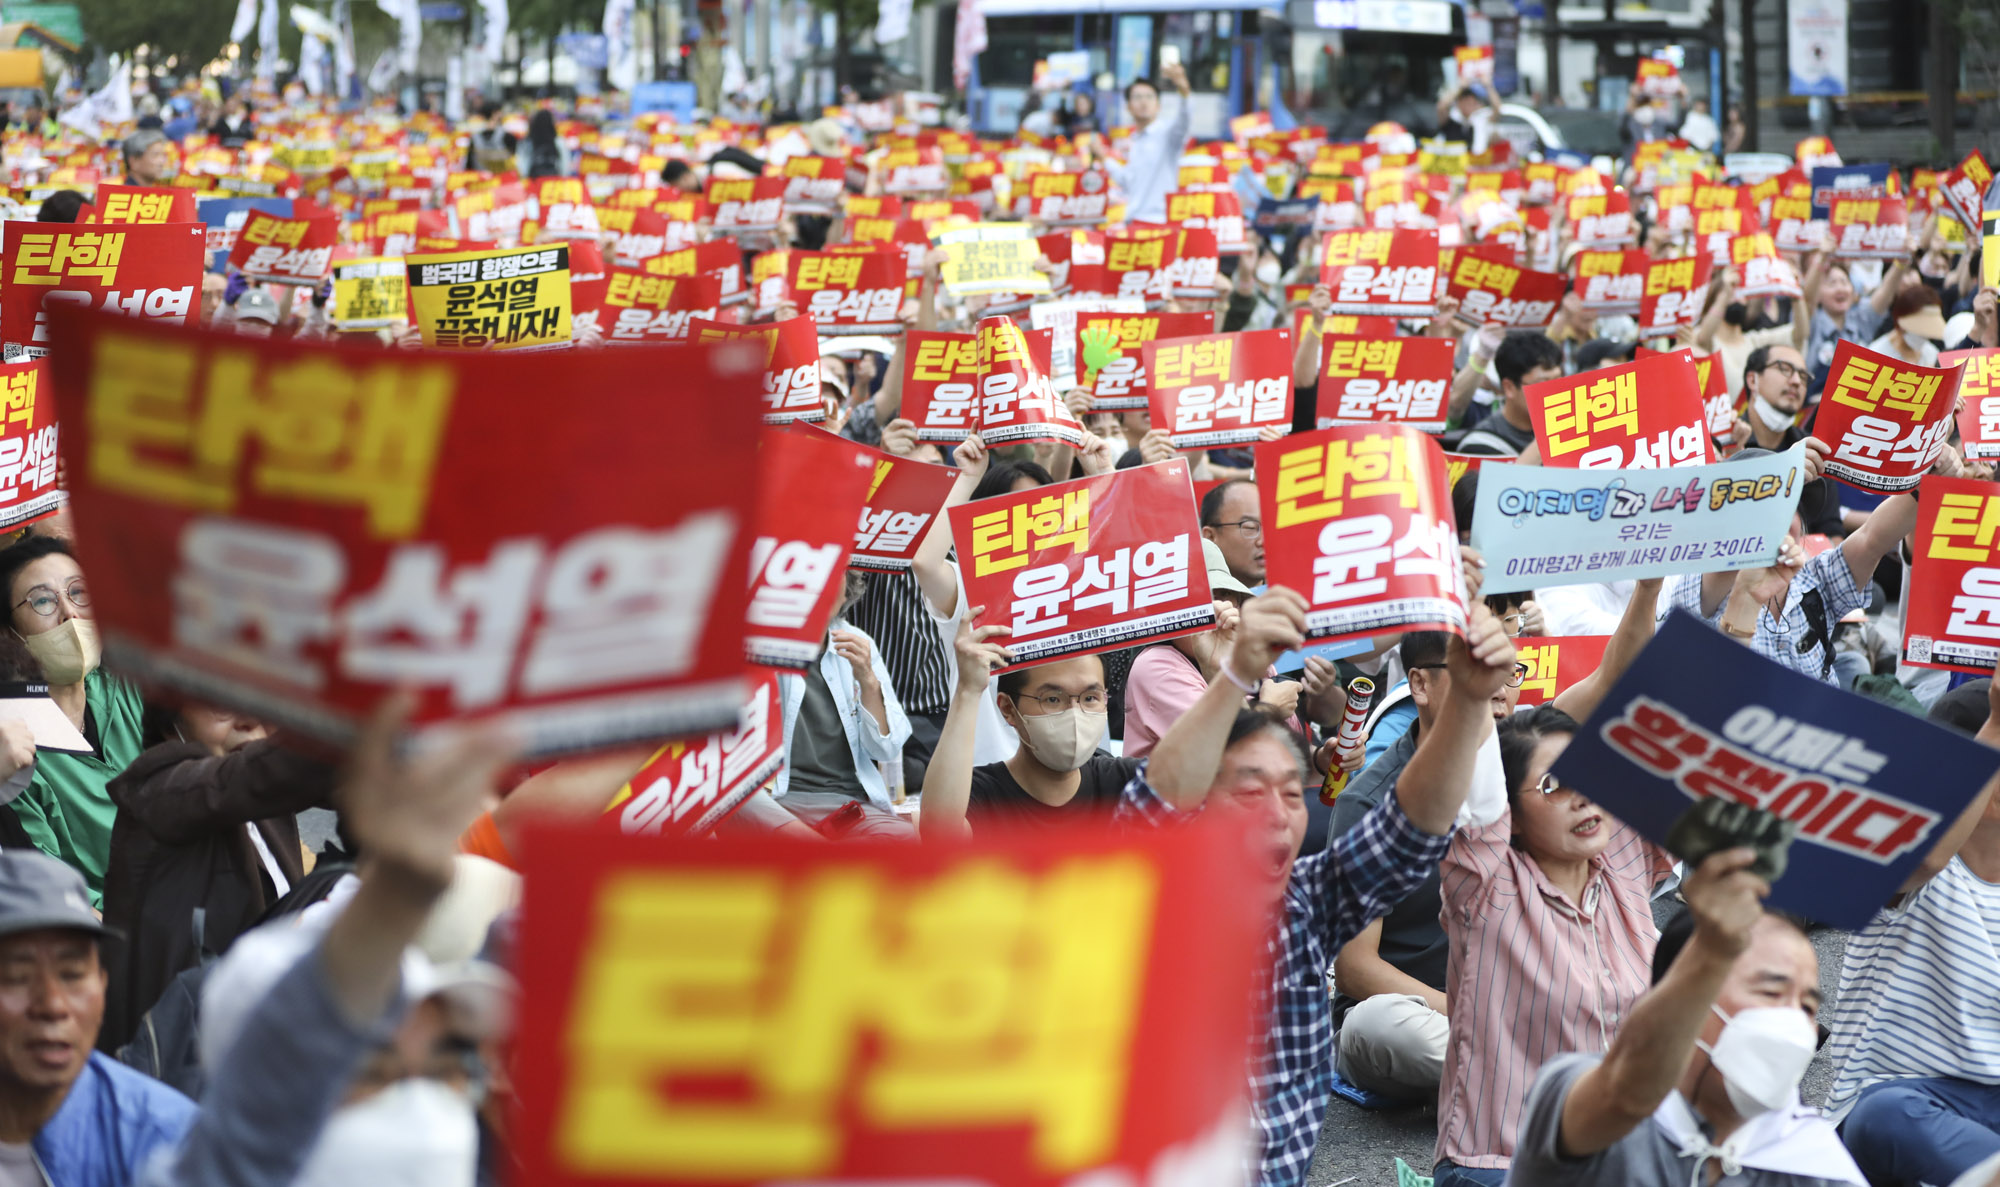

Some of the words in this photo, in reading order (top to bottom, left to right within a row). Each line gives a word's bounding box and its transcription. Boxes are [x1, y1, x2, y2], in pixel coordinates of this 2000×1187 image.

[103, 193, 174, 224] 탄핵
[243, 216, 310, 249] 탄핵
[1326, 231, 1394, 266] 탄핵
[13, 232, 126, 286] 탄핵
[242, 246, 333, 276] 윤석열
[421, 261, 478, 285] 범국민
[481, 250, 558, 280] 항쟁으로
[796, 257, 863, 290] 탄핵
[1454, 256, 1521, 298] 탄핵
[446, 277, 539, 317] 윤석열
[605, 273, 676, 309] 탄핵
[808, 287, 903, 322] 윤석열
[1338, 266, 1436, 302] 윤석열
[1460, 289, 1555, 325] 윤석열
[1154, 339, 1233, 389] 탄핵
[1327, 340, 1402, 378] 탄핵
[761, 360, 821, 408] 석열
[1175, 376, 1289, 432] 윤석열
[1337, 379, 1446, 418] 윤석열
[1831, 356, 1943, 421] 탄핵
[1543, 371, 1639, 458] 탄핵
[87, 336, 455, 538] 탄핵
[1275, 434, 1420, 529] 탄핵
[1498, 482, 1646, 521] 이재명과
[1651, 477, 1705, 513] 나는
[1875, 477, 1903, 485] 촛불대행진
[854, 507, 931, 552] 석열
[972, 488, 1089, 578] 탄핵
[1617, 522, 1673, 543] 우리는
[1927, 493, 2000, 562] 탄
[1312, 513, 1465, 604] 윤석
[1505, 554, 1584, 577] 이재명과
[1586, 551, 1623, 571] 함께
[1627, 547, 1665, 568] 싸워
[1670, 545, 1704, 562] 이길
[1710, 536, 1765, 559] 것이다.
[171, 509, 738, 706] 윤석열
[1011, 533, 1189, 638] 윤석열
[1068, 627, 1106, 642] 촛불대행진
[1515, 645, 1559, 699] 핵
[1722, 704, 1889, 783] 이제는
[1603, 697, 1939, 863] 항쟁이다
[556, 854, 1154, 1176] 탄핵
